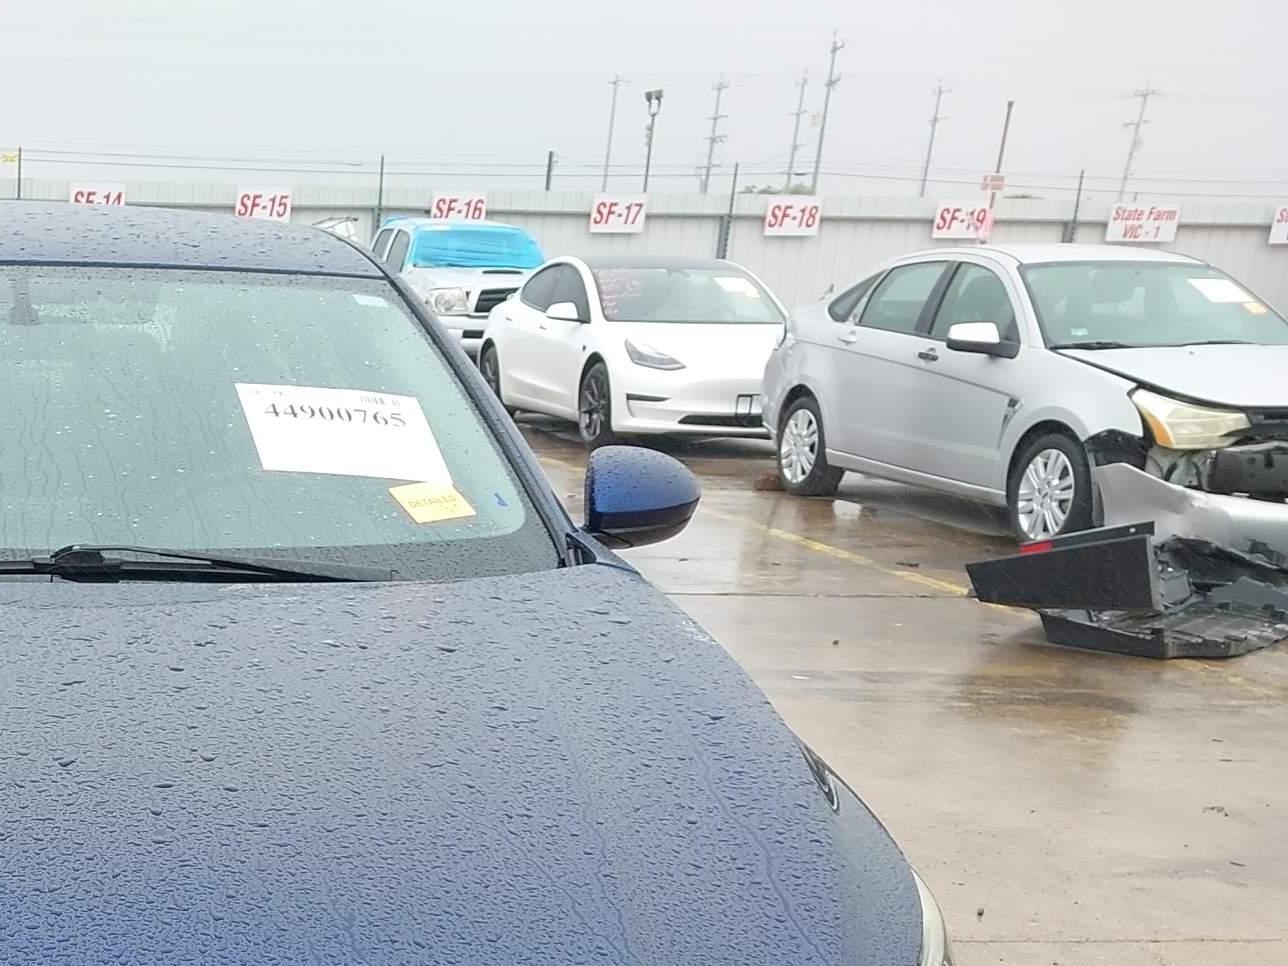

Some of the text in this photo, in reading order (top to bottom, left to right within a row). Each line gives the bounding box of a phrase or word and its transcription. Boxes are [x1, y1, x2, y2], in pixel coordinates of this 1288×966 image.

[238, 194, 289, 217] SF-15
[434, 198, 485, 219] SF-16
[593, 202, 644, 226] SF-17
[768, 204, 819, 229] SF-18
[1113, 206, 1177, 221] State Farm
[1122, 224, 1143, 240] VIC
[264, 402, 407, 428] 44900765
